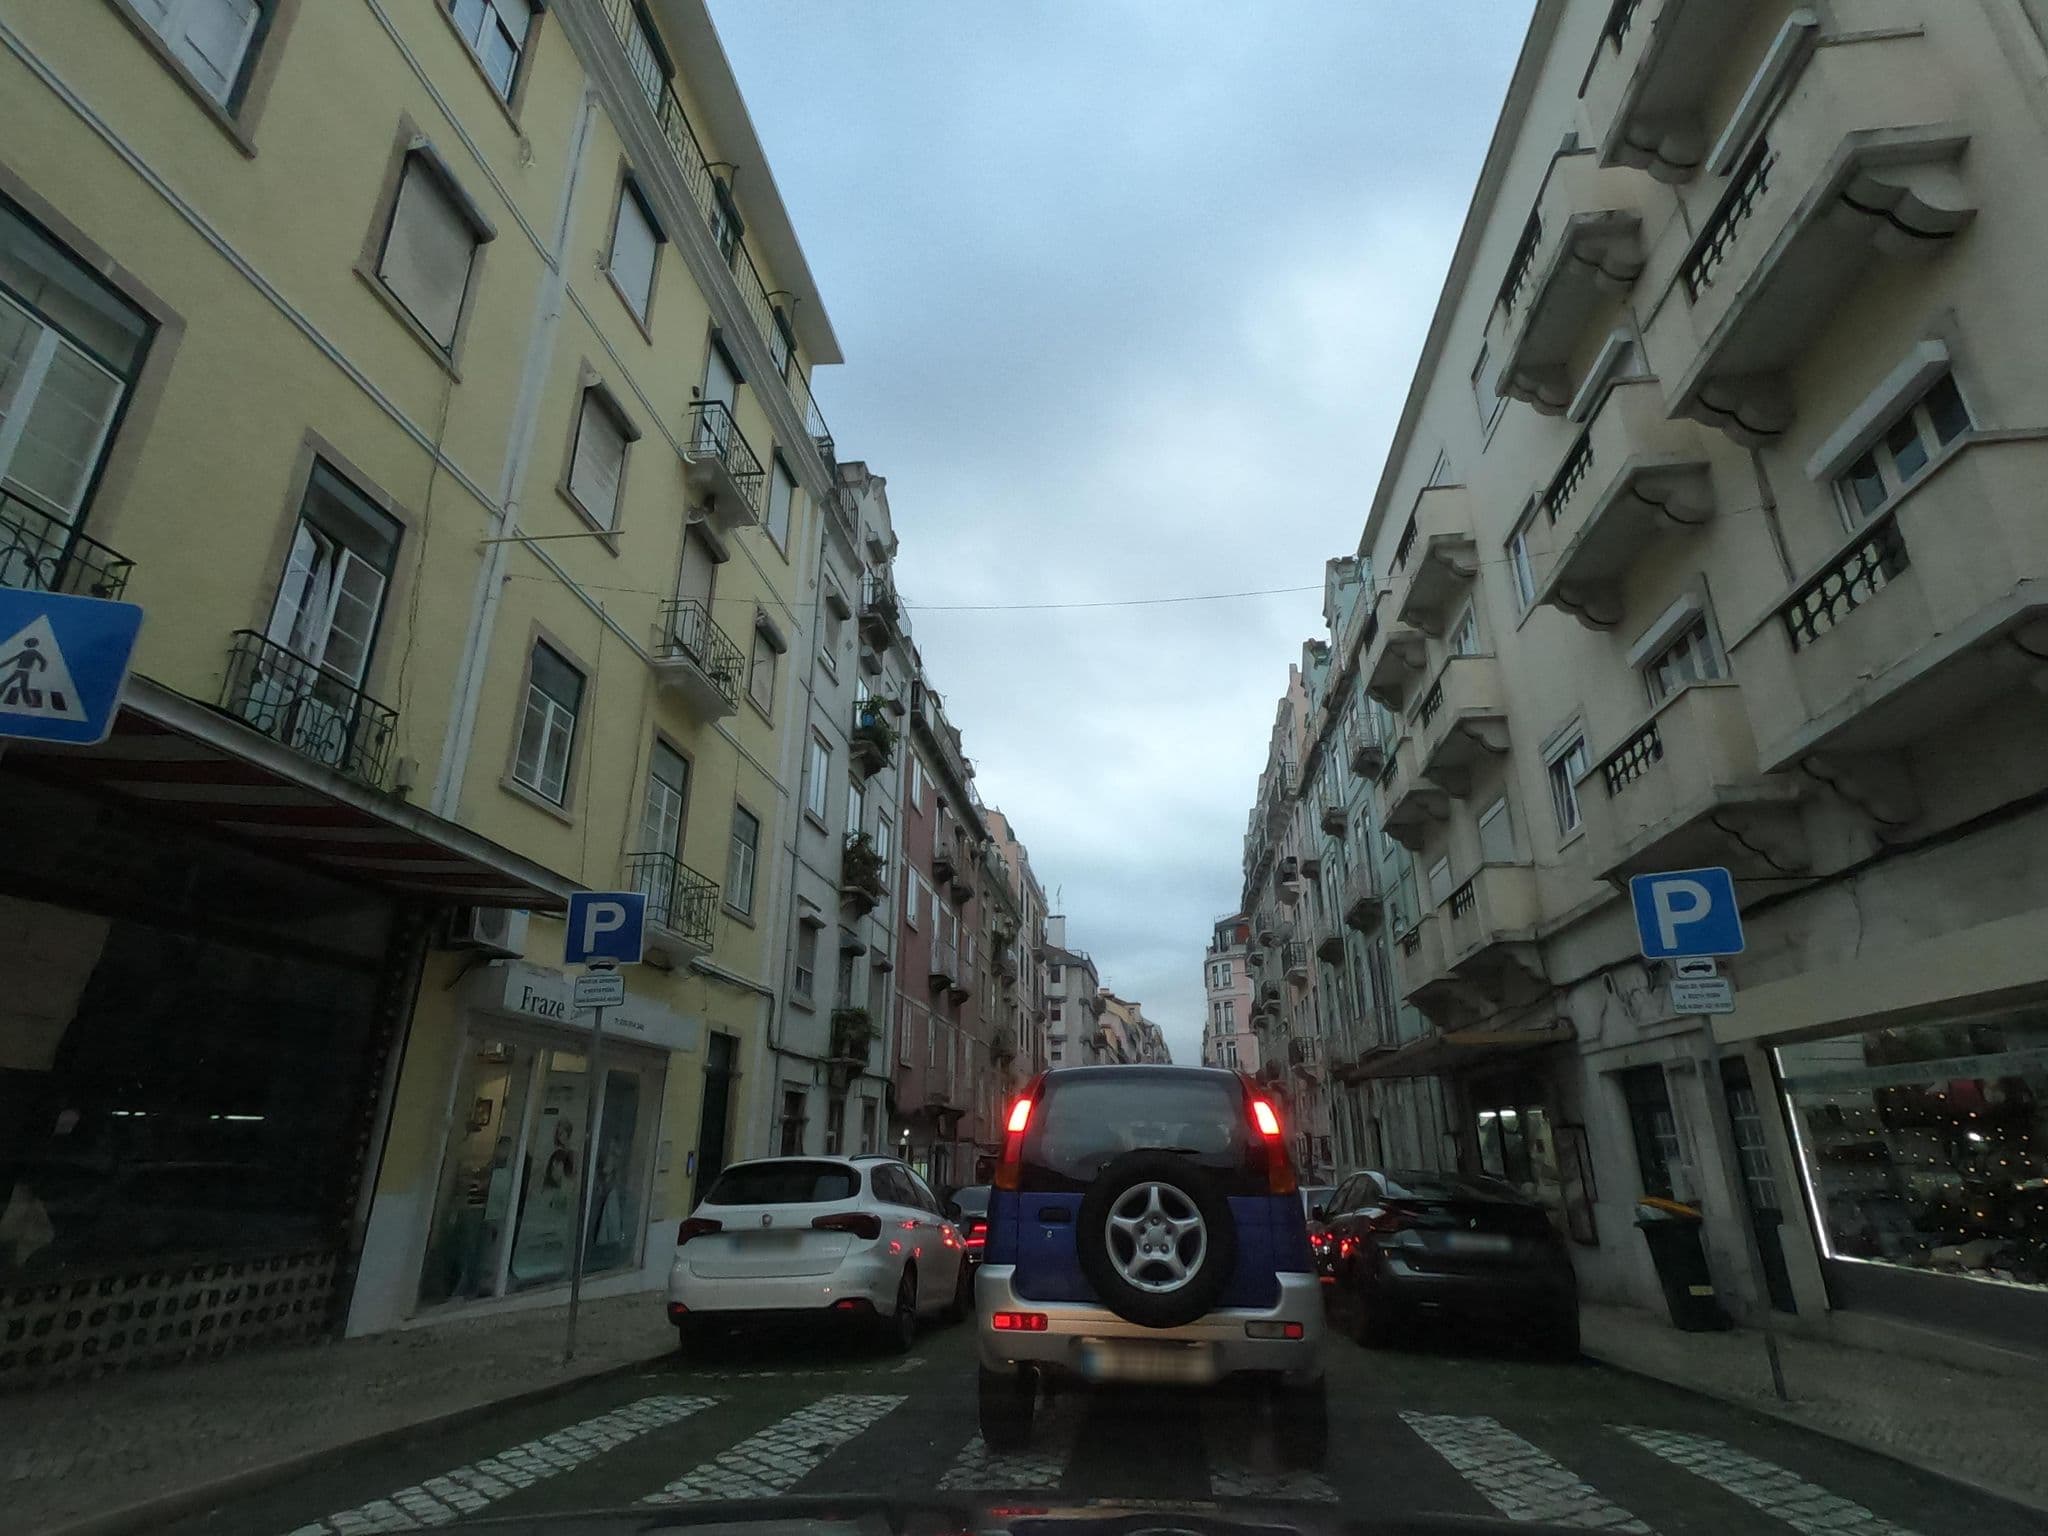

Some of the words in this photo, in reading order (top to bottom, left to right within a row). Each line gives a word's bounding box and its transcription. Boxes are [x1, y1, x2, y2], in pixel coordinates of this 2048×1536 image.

[583, 902, 626, 953] P
[1652, 879, 1711, 949] P
[520, 986, 565, 1018] Fraze
